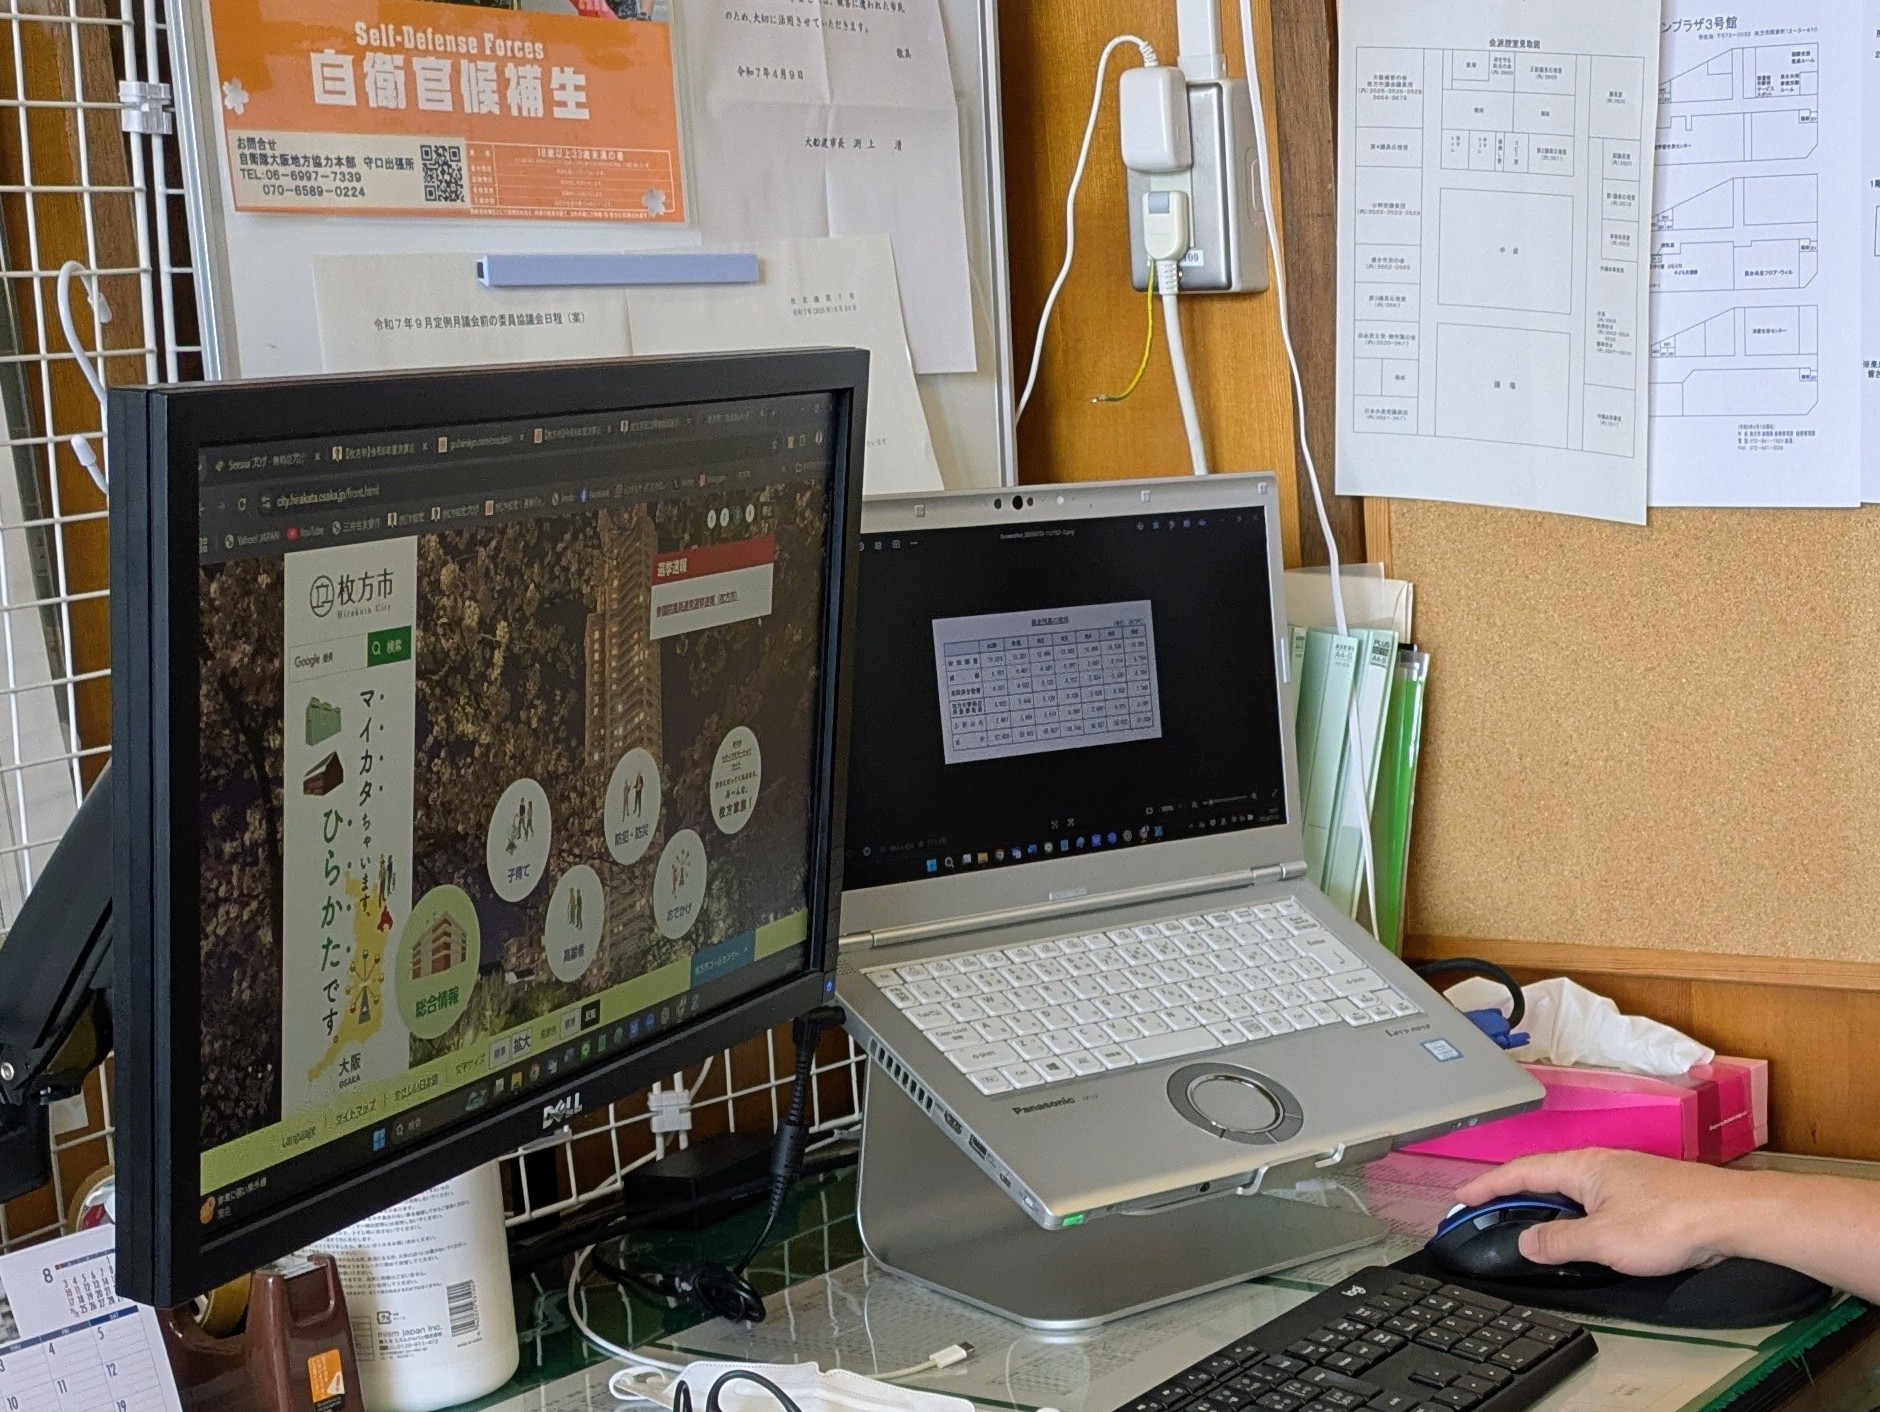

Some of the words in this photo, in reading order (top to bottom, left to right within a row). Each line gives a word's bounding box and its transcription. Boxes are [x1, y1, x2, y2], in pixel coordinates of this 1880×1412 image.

[355, 21, 478, 54] Self-Defense
[484, 32, 544, 59] Forces
[310, 49, 590, 120] 自衛官候補生
[237, 137, 277, 151] お問合せ
[239, 152, 356, 169] 自衛隊大阪地方協力本部
[363, 156, 415, 171] 守口出張所
[338, 568, 394, 606] 枚方市
[295, 653, 320, 668] Google
[507, 864, 530, 884] 子育て
[416, 986, 460, 1018] 総合情報
[513, 1035, 531, 1055] 拡大
[339, 1053, 361, 1077] 大阪
[542, 1092, 582, 1130] DELL
[1012, 1097, 1076, 1115] Panasonic
[42, 1268, 54, 1283] 8
[48, 1342, 55, 1355] 4
[98, 1327, 104, 1340] 5
[7, 1396, 19, 1411] 10
[57, 1379, 67, 1393] 11
[106, 1362, 118, 1378] 12
